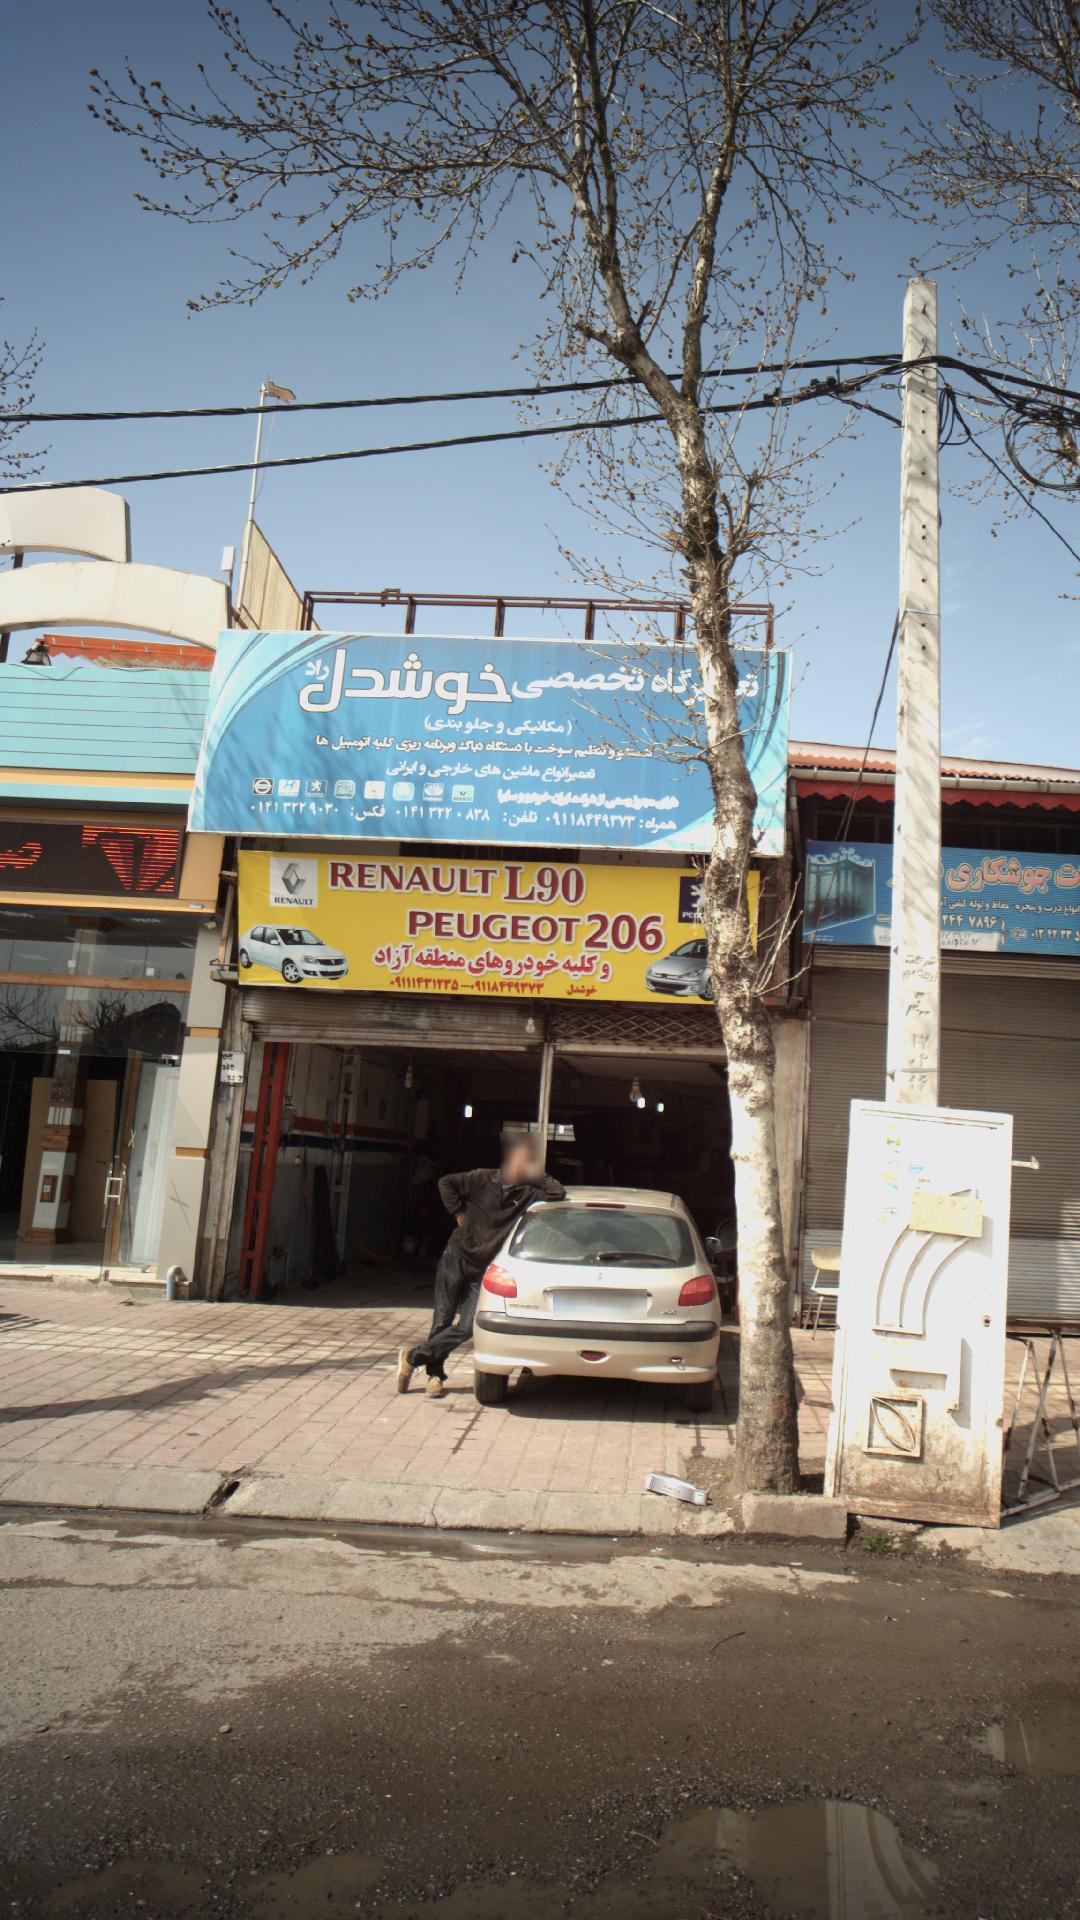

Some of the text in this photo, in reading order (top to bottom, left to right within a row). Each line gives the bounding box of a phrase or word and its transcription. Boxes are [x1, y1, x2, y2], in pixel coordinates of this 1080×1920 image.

[304, 659, 330, 680] راد
[299, 648, 513, 715] خوشدل
[511, 666, 645, 699] تخصصی
[465, 717, 494, 734] جلو
[496, 721, 504, 734] و
[316, 734, 329, 746] ها
[332, 735, 371, 751] اتومبیل
[486, 740, 523, 752] دستگاه
[524, 742, 533, 755] با
[534, 741, 573, 758] سوخت
[386, 760, 418, 777] ایرانی
[418, 763, 427, 776] و
[427, 761, 473, 778] خارجی
[474, 762, 500, 778] های
[502, 763, 541, 780] ماشین
[329, 862, 585, 904] RENAULT L90
[947, 857, 1049, 893] جوشکاری
[274, 896, 314, 906] RENAULT
[408, 910, 664, 951] PEUGEOT 206
[373, 943, 414, 970] آزاد
[415, 946, 466, 968] منطقه
[562, 954, 598, 977] کلیه
[600, 962, 611, 980] و
